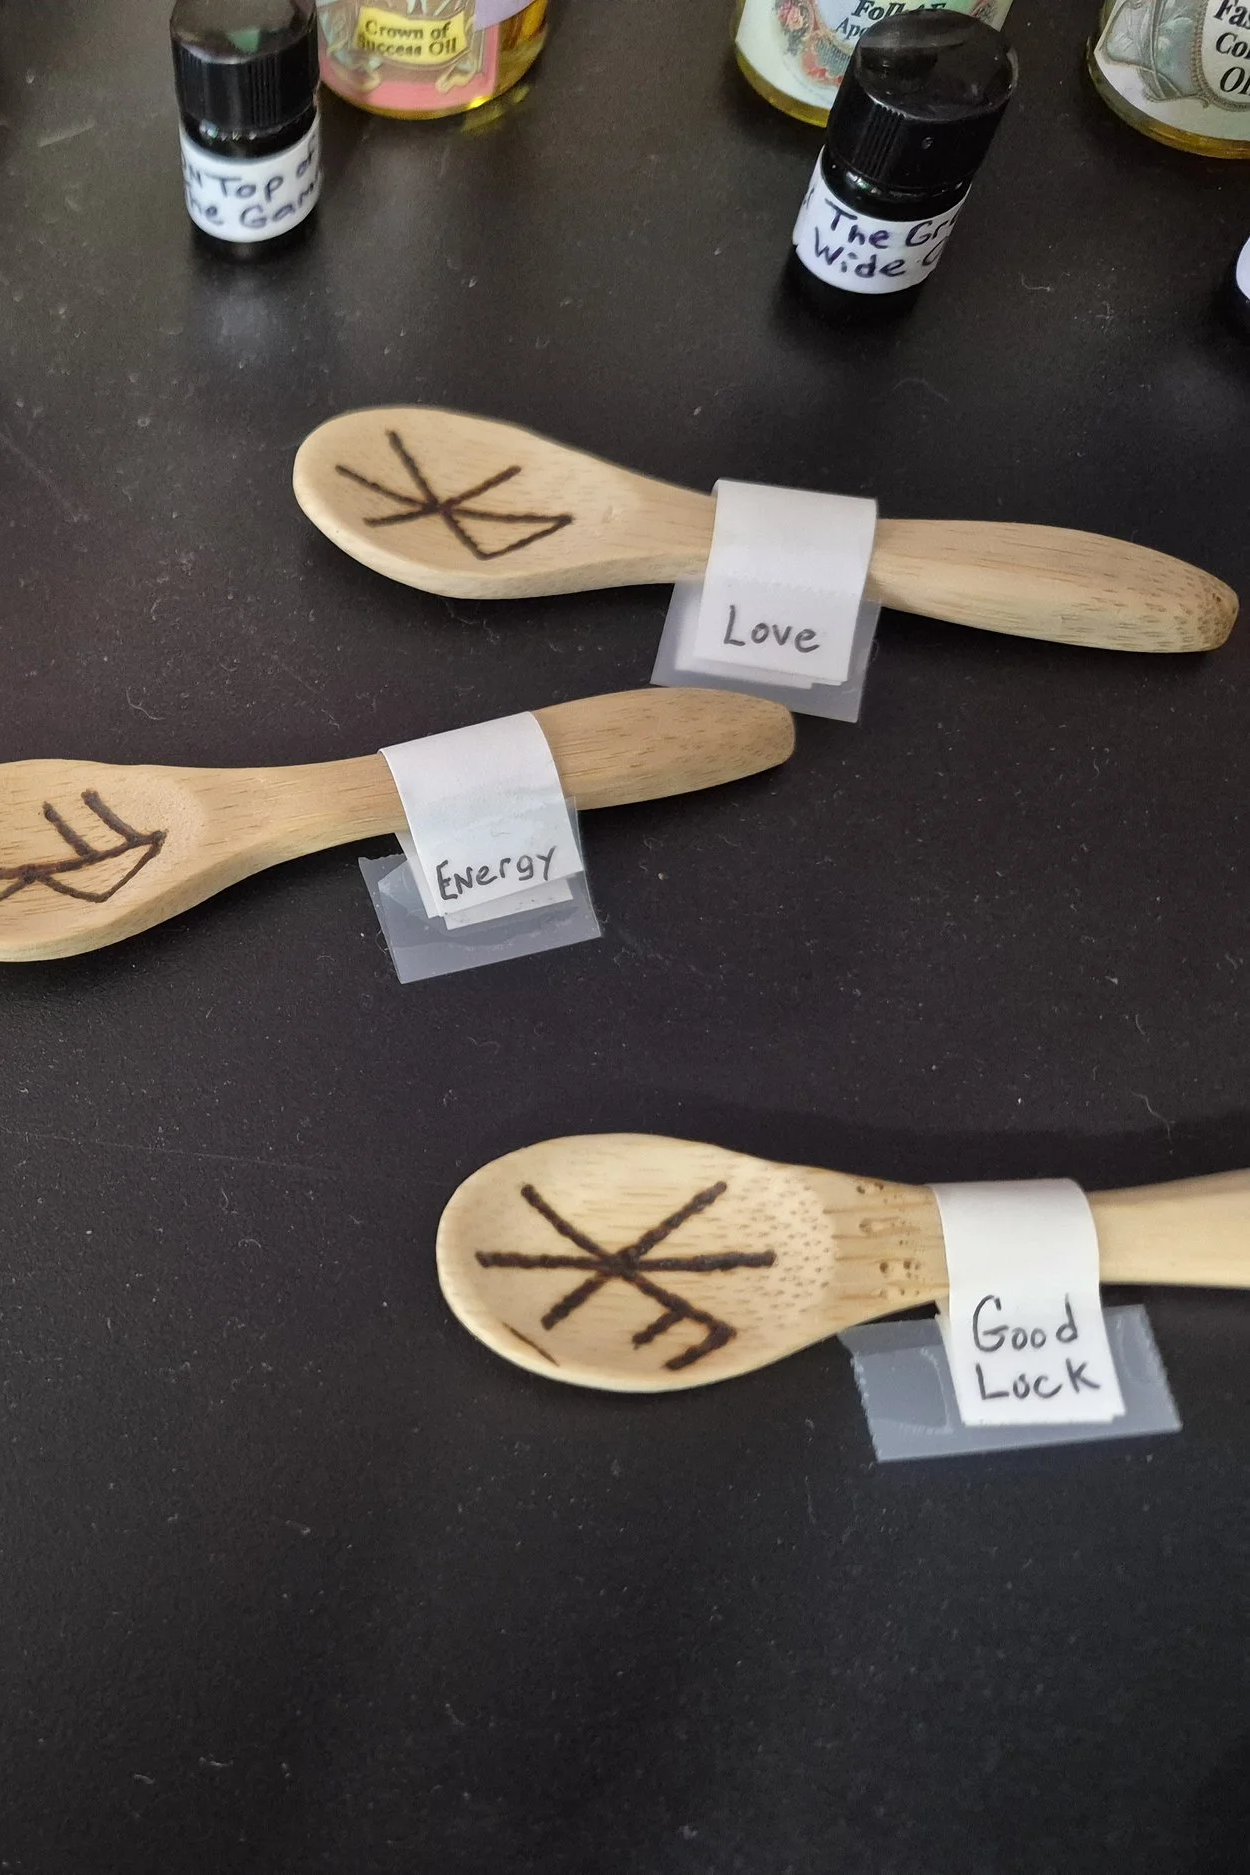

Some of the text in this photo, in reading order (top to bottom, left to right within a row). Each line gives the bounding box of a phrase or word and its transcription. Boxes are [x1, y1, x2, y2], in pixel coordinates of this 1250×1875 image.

[365, 18, 452, 40] Crown of
[204, 171, 284, 203] Top
[824, 198, 890, 250] The
[814, 226, 906, 279] Wide
[723, 604, 820, 653] Love
[972, 1292, 1079, 1353] Good
